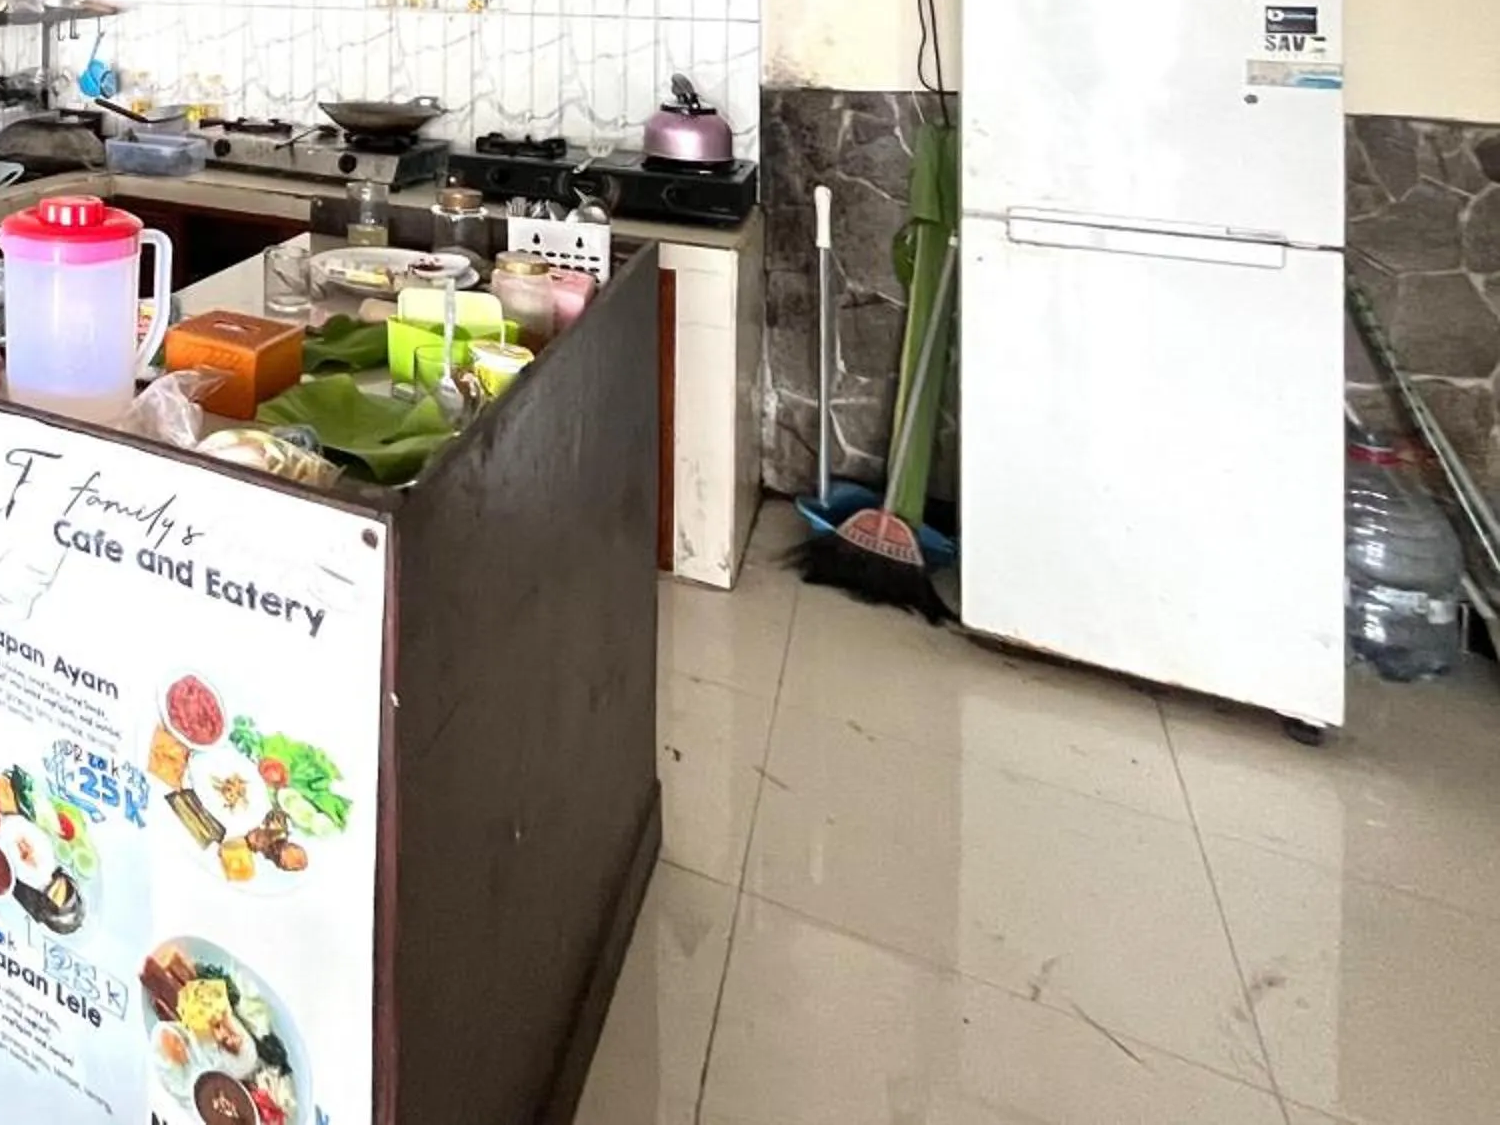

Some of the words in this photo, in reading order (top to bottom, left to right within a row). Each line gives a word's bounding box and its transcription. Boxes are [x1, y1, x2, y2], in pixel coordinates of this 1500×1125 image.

[53, 520, 125, 563] Cafe
[136, 547, 195, 589] and
[205, 567, 326, 638] Eatery
[53, 655, 119, 700] Ayam
[55, 982, 103, 1028] Lele
